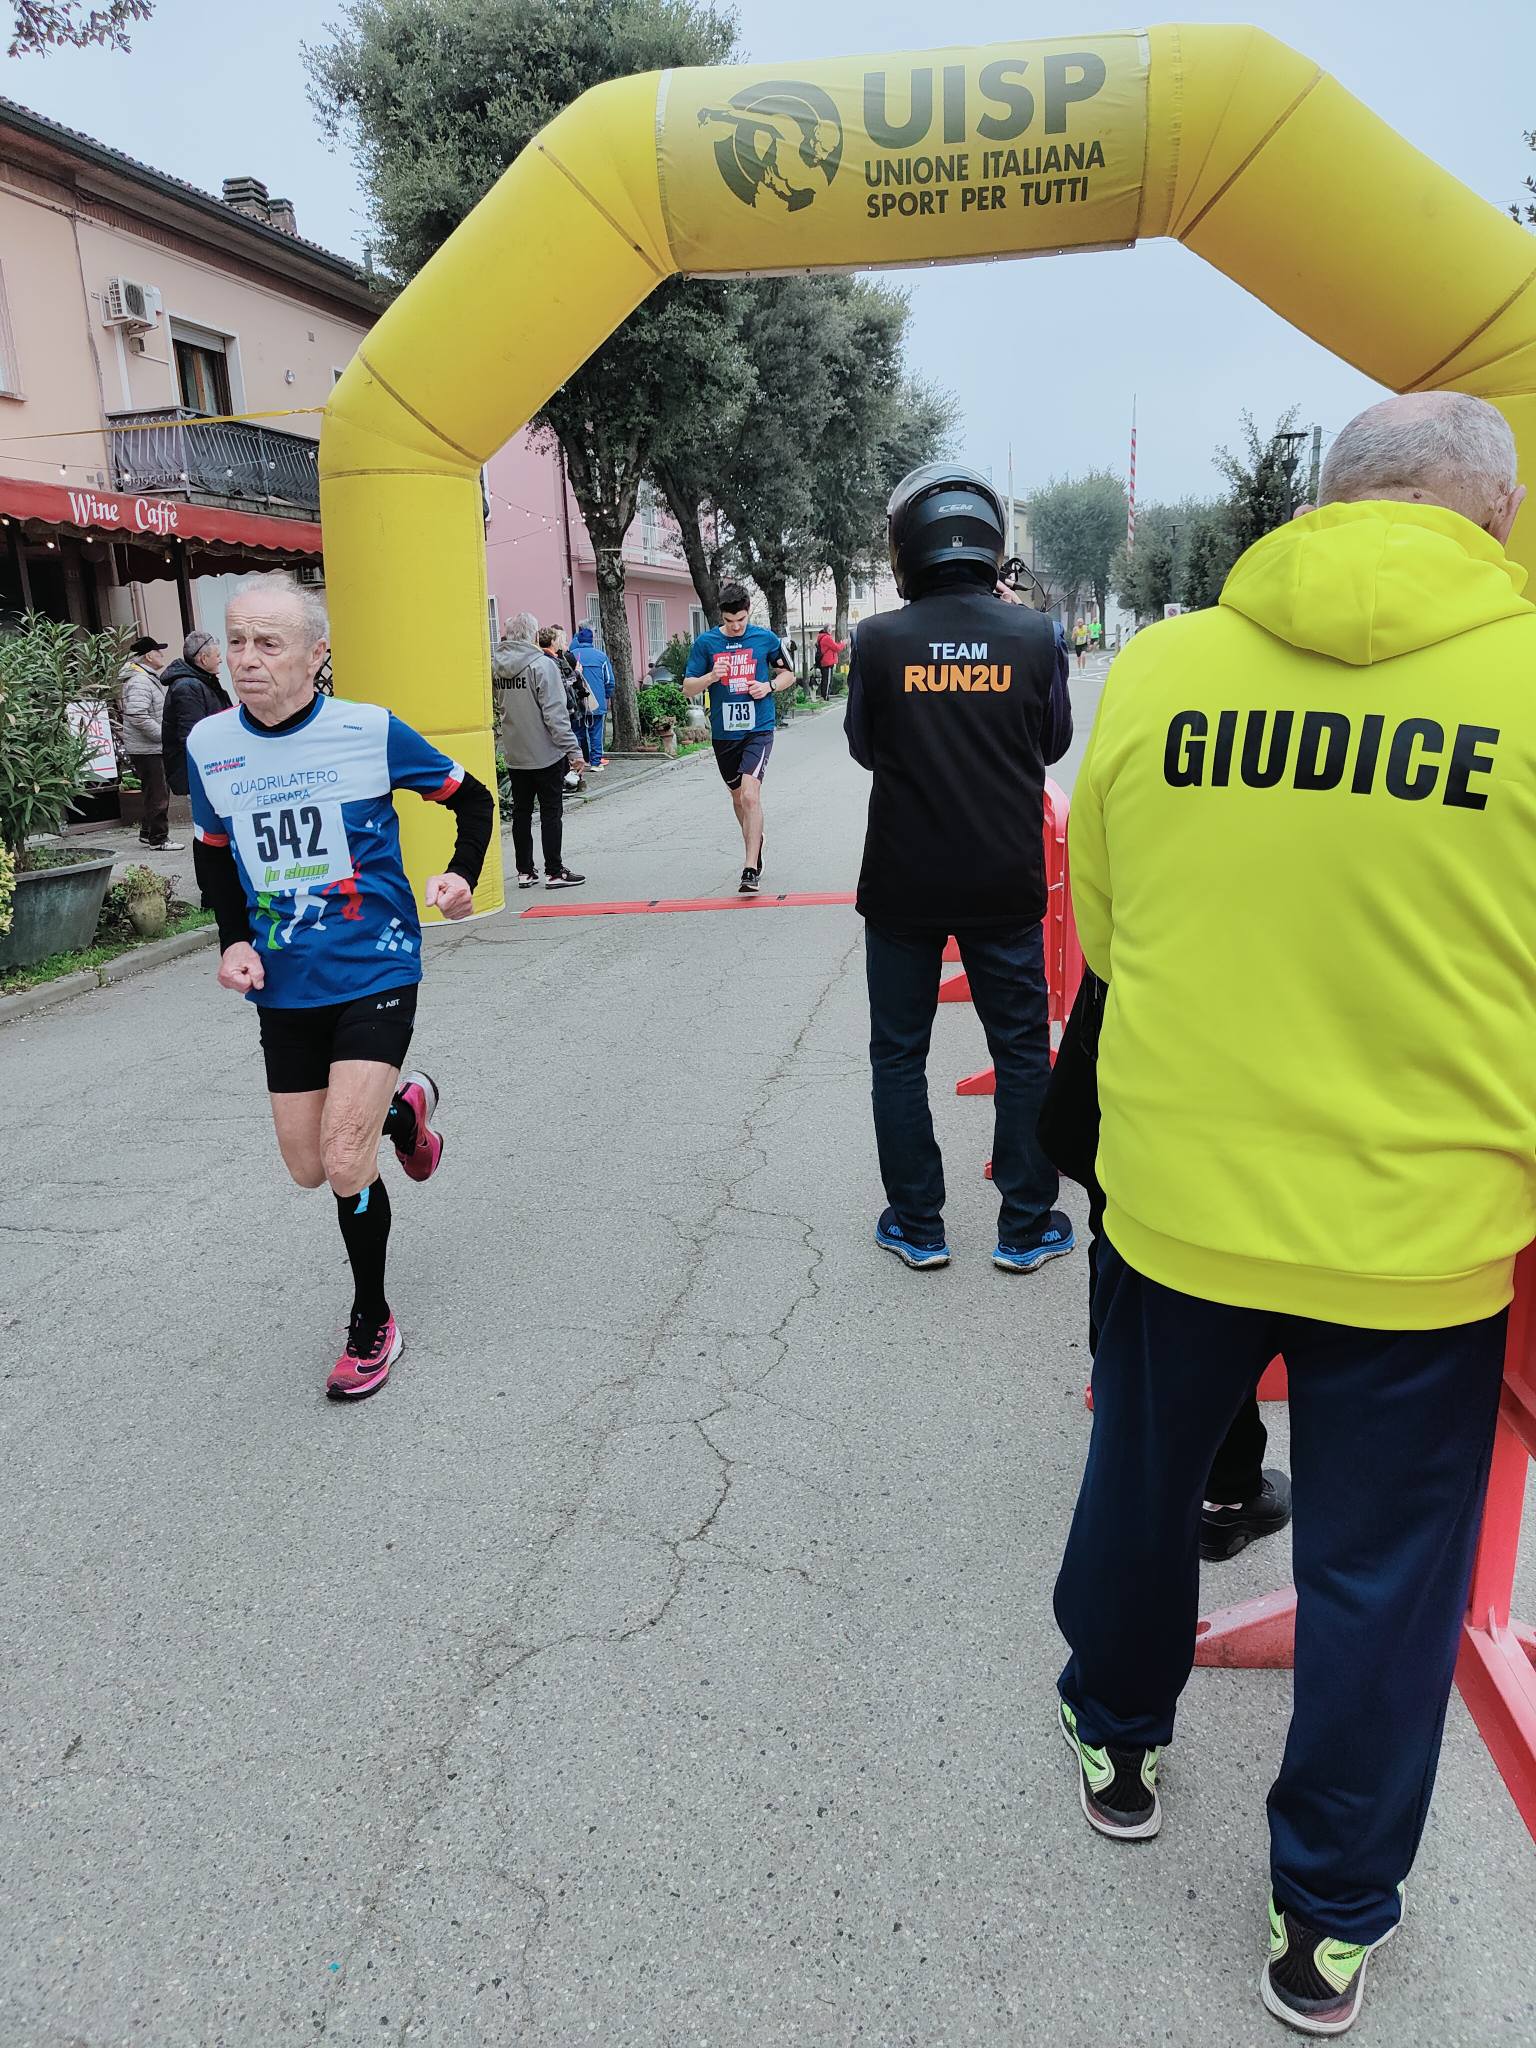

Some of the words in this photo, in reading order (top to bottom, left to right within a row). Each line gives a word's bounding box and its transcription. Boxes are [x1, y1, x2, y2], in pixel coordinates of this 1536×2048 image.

[864, 52, 1107, 149] UISP
[864, 153, 969, 188] UNIONE
[983, 140, 1106, 179] ITALIANA
[866, 189, 947, 219] SPORT
[961, 185, 1006, 212] PER
[1021, 177, 1088, 207] TUTTI
[67, 492, 121, 525] Wine
[135, 498, 179, 536] Caffè
[730, 654, 748, 666] TIME
[928, 642, 988, 660] TEAM
[730, 665, 739, 676] TO
[740, 663, 755, 676] RUN
[904, 665, 1012, 693] RUN2U
[728, 704, 751, 721] 733
[1163, 710, 1500, 811] GIUDICE
[230, 770, 338, 796] QUADRILATERO
[256, 789, 311, 807] FERRARA
[251, 805, 328, 862] 542
[1041, 1230, 1062, 1243] HOKA
